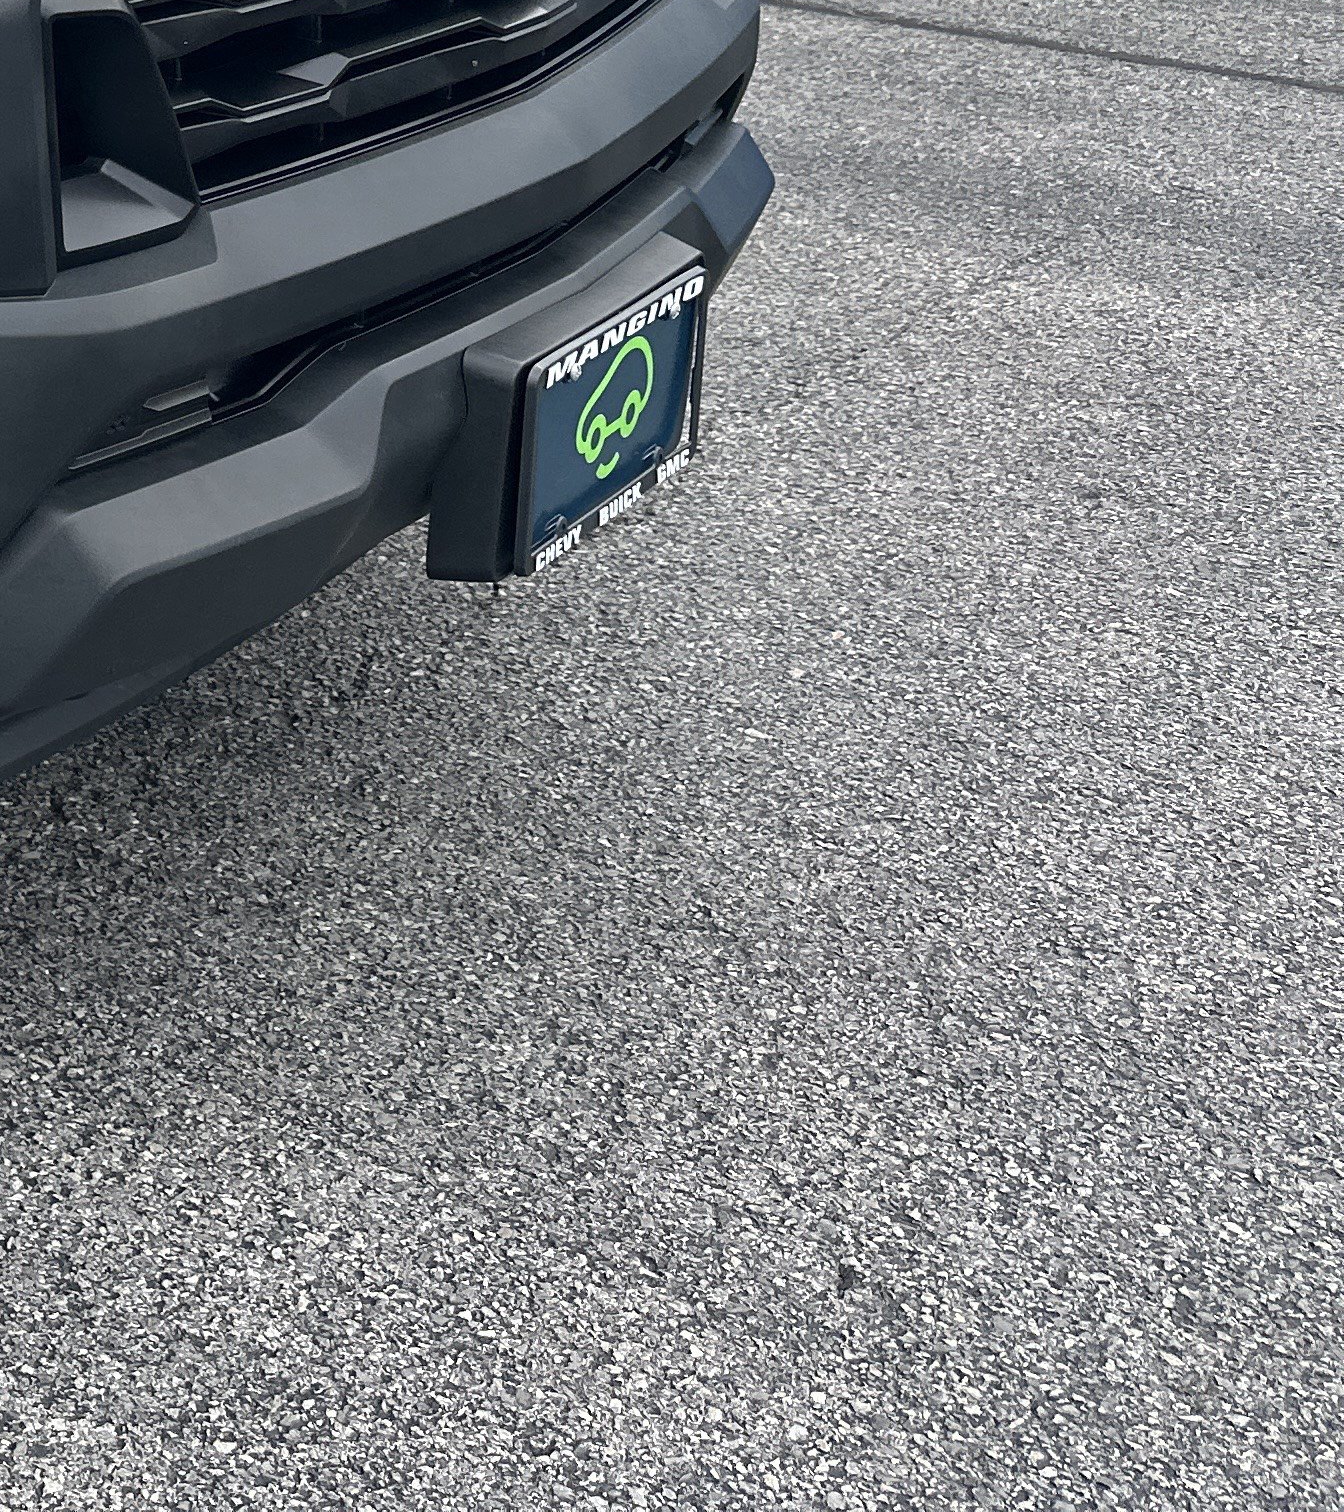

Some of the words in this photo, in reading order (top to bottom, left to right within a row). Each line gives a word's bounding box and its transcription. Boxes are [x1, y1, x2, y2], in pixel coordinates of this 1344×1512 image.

[546, 276, 705, 389] MANGINO
[535, 525, 582, 571] CHEVY
[599, 482, 643, 527] BUICK
[656, 448, 690, 485] GMC
